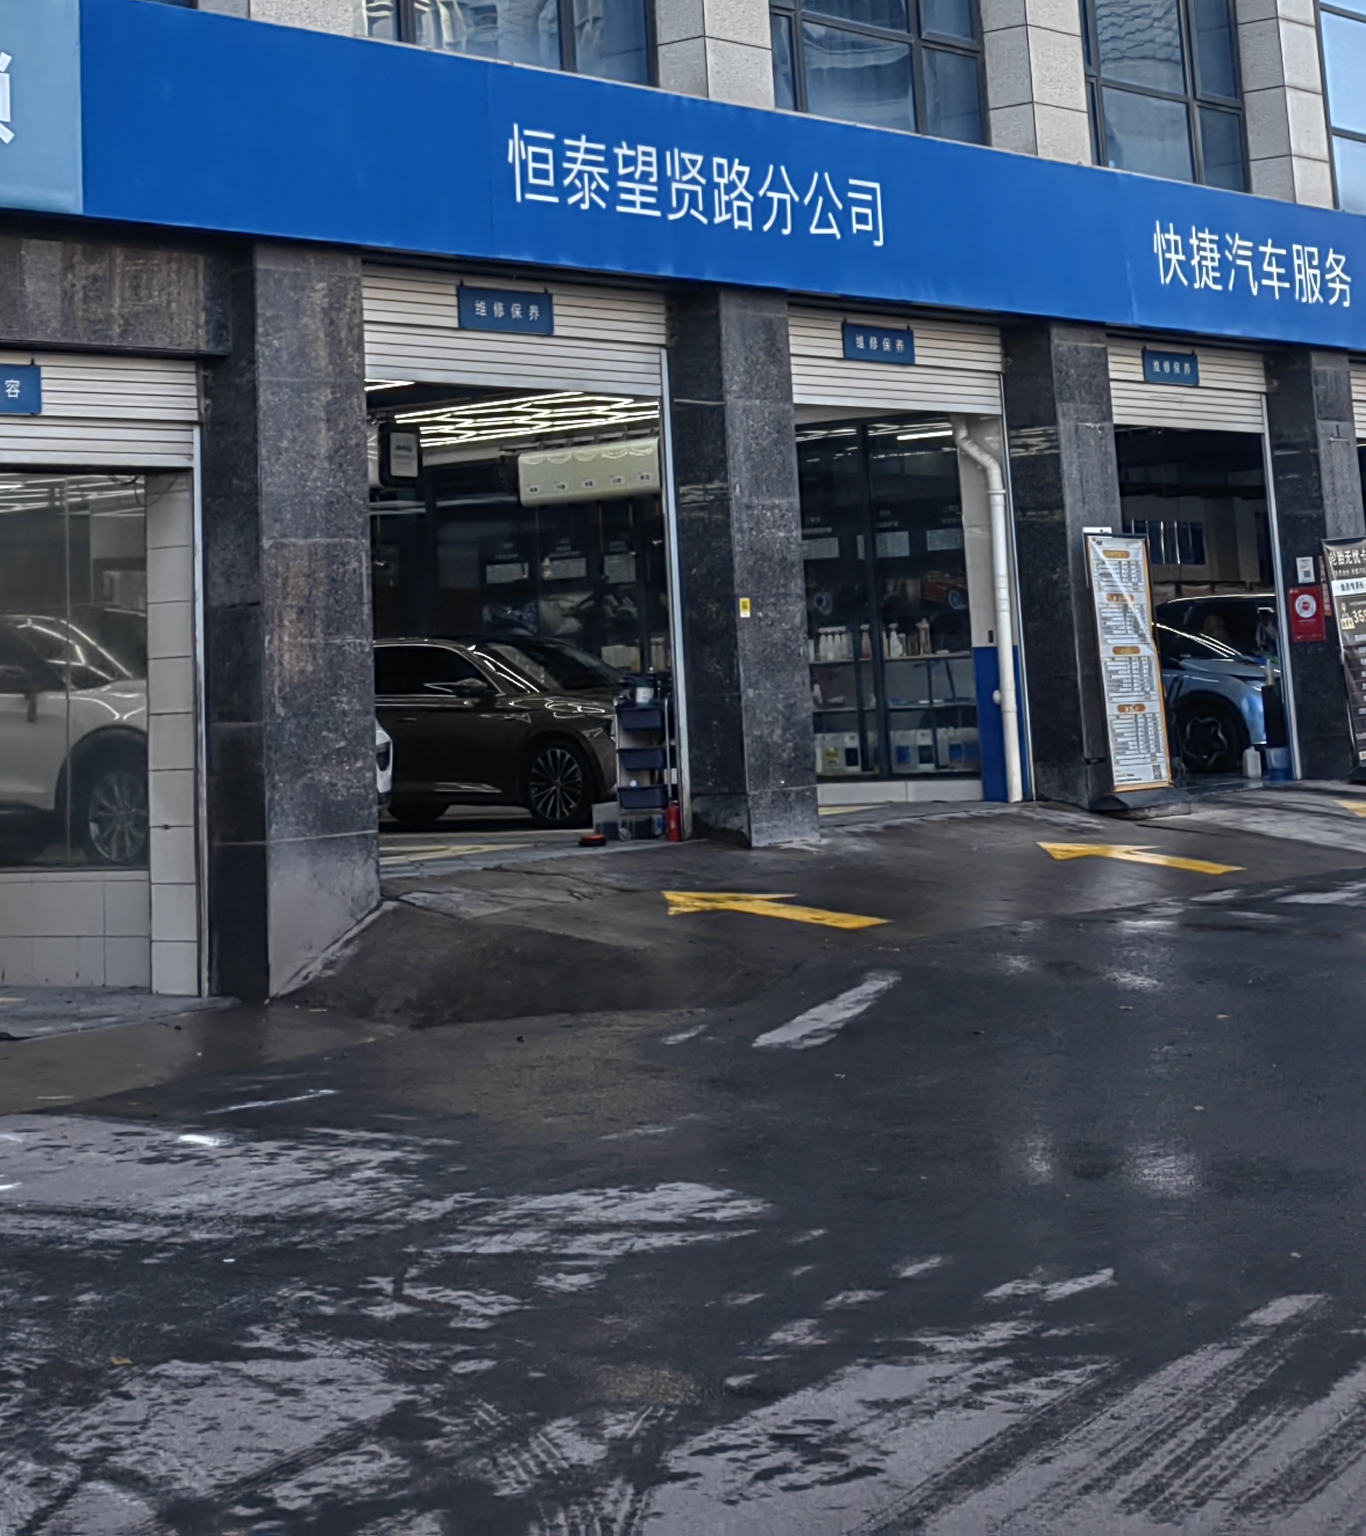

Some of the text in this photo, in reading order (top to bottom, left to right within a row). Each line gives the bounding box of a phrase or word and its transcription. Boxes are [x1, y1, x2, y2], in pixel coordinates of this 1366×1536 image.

[508, 122, 884, 247] 恒泰望贤路分公司
[1153, 221, 1353, 308] 快捷汽车服务
[475, 300, 541, 321] 维修保养
